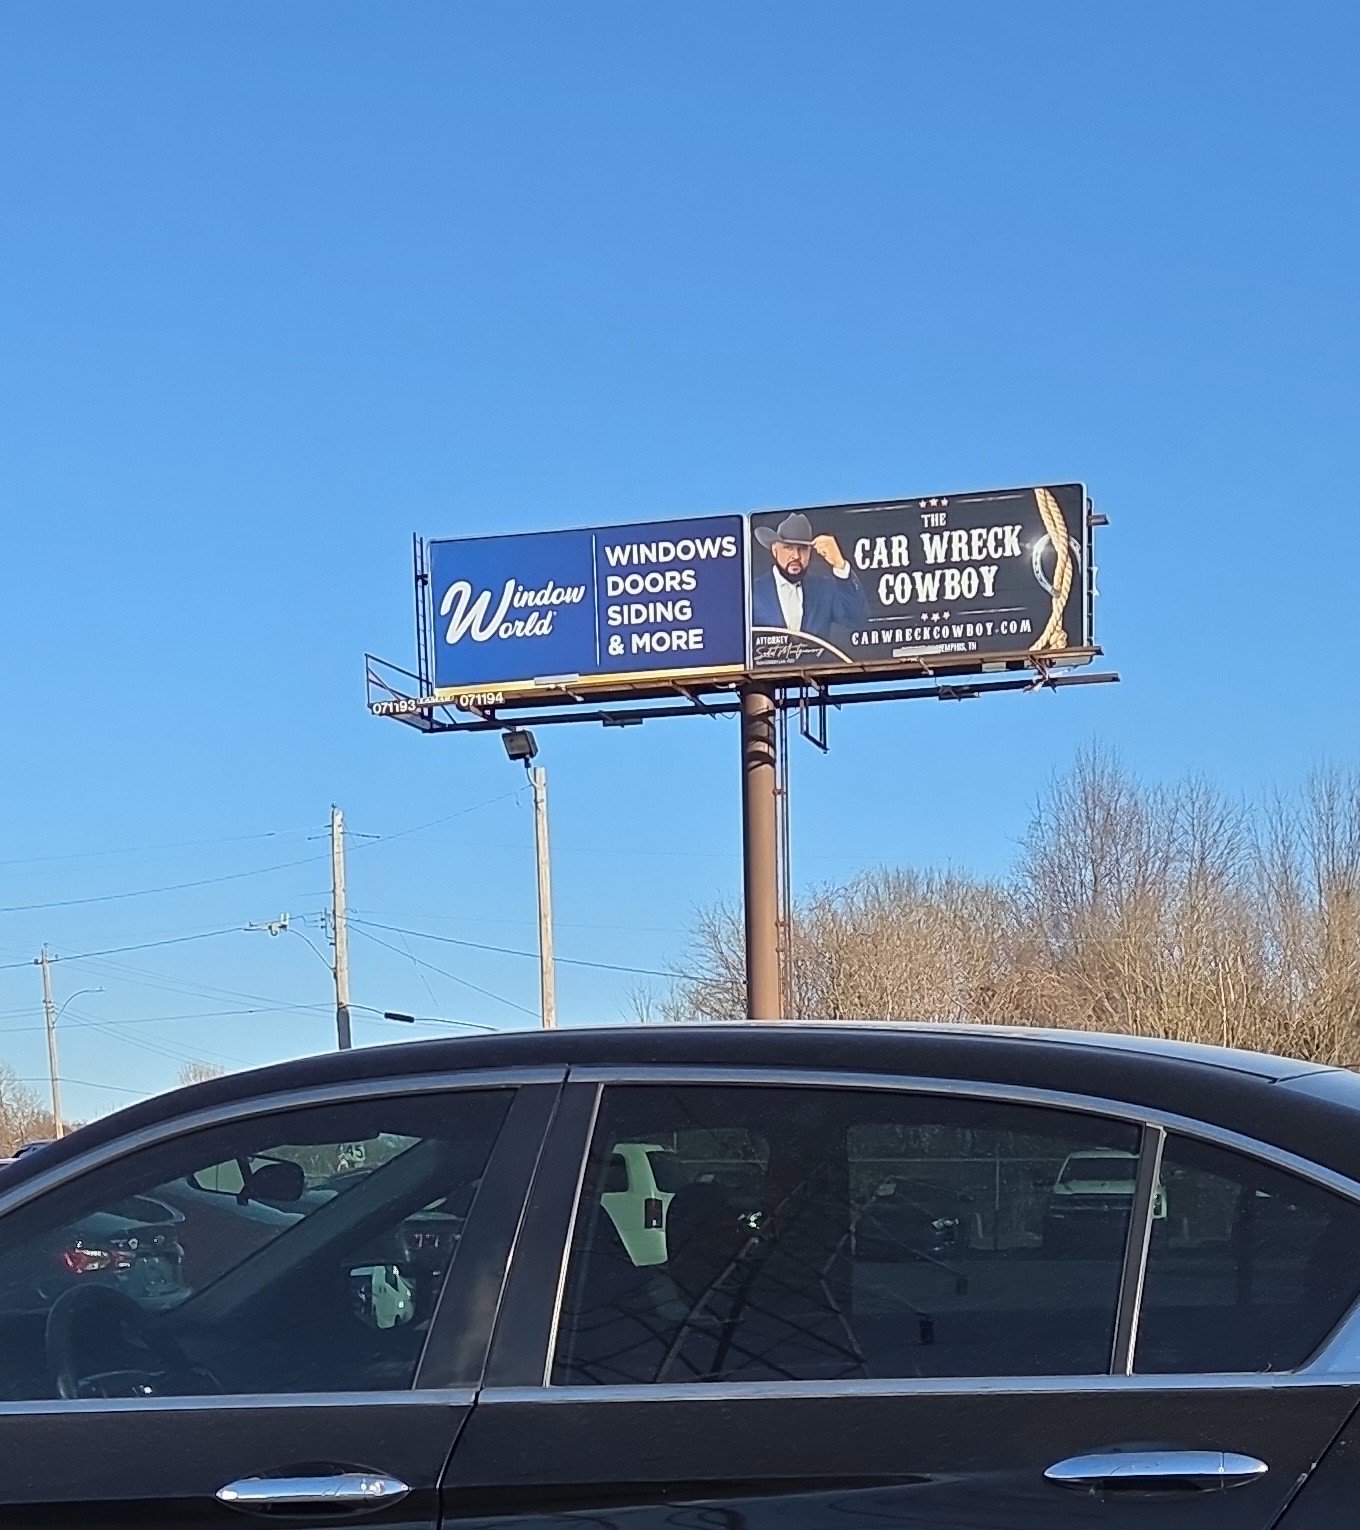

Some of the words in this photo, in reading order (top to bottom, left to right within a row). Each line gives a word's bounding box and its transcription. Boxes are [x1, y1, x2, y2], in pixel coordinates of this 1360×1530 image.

[921, 513, 947, 528] THE
[604, 536, 737, 567] WINDOWS
[854, 535, 910, 570] CAR
[920, 525, 1022, 564] WRECK
[606, 569, 697, 597] DOORS
[878, 565, 998, 605] COWBOY
[440, 579, 585, 644] Window
[607, 600, 693, 626] SIDING
[608, 635, 625, 655] &
[631, 629, 704, 654] MORE
[852, 619, 1032, 645] CARWRECKCOWBOY.COM
[372, 699, 416, 715] 071193
[460, 692, 504, 707] 071194
